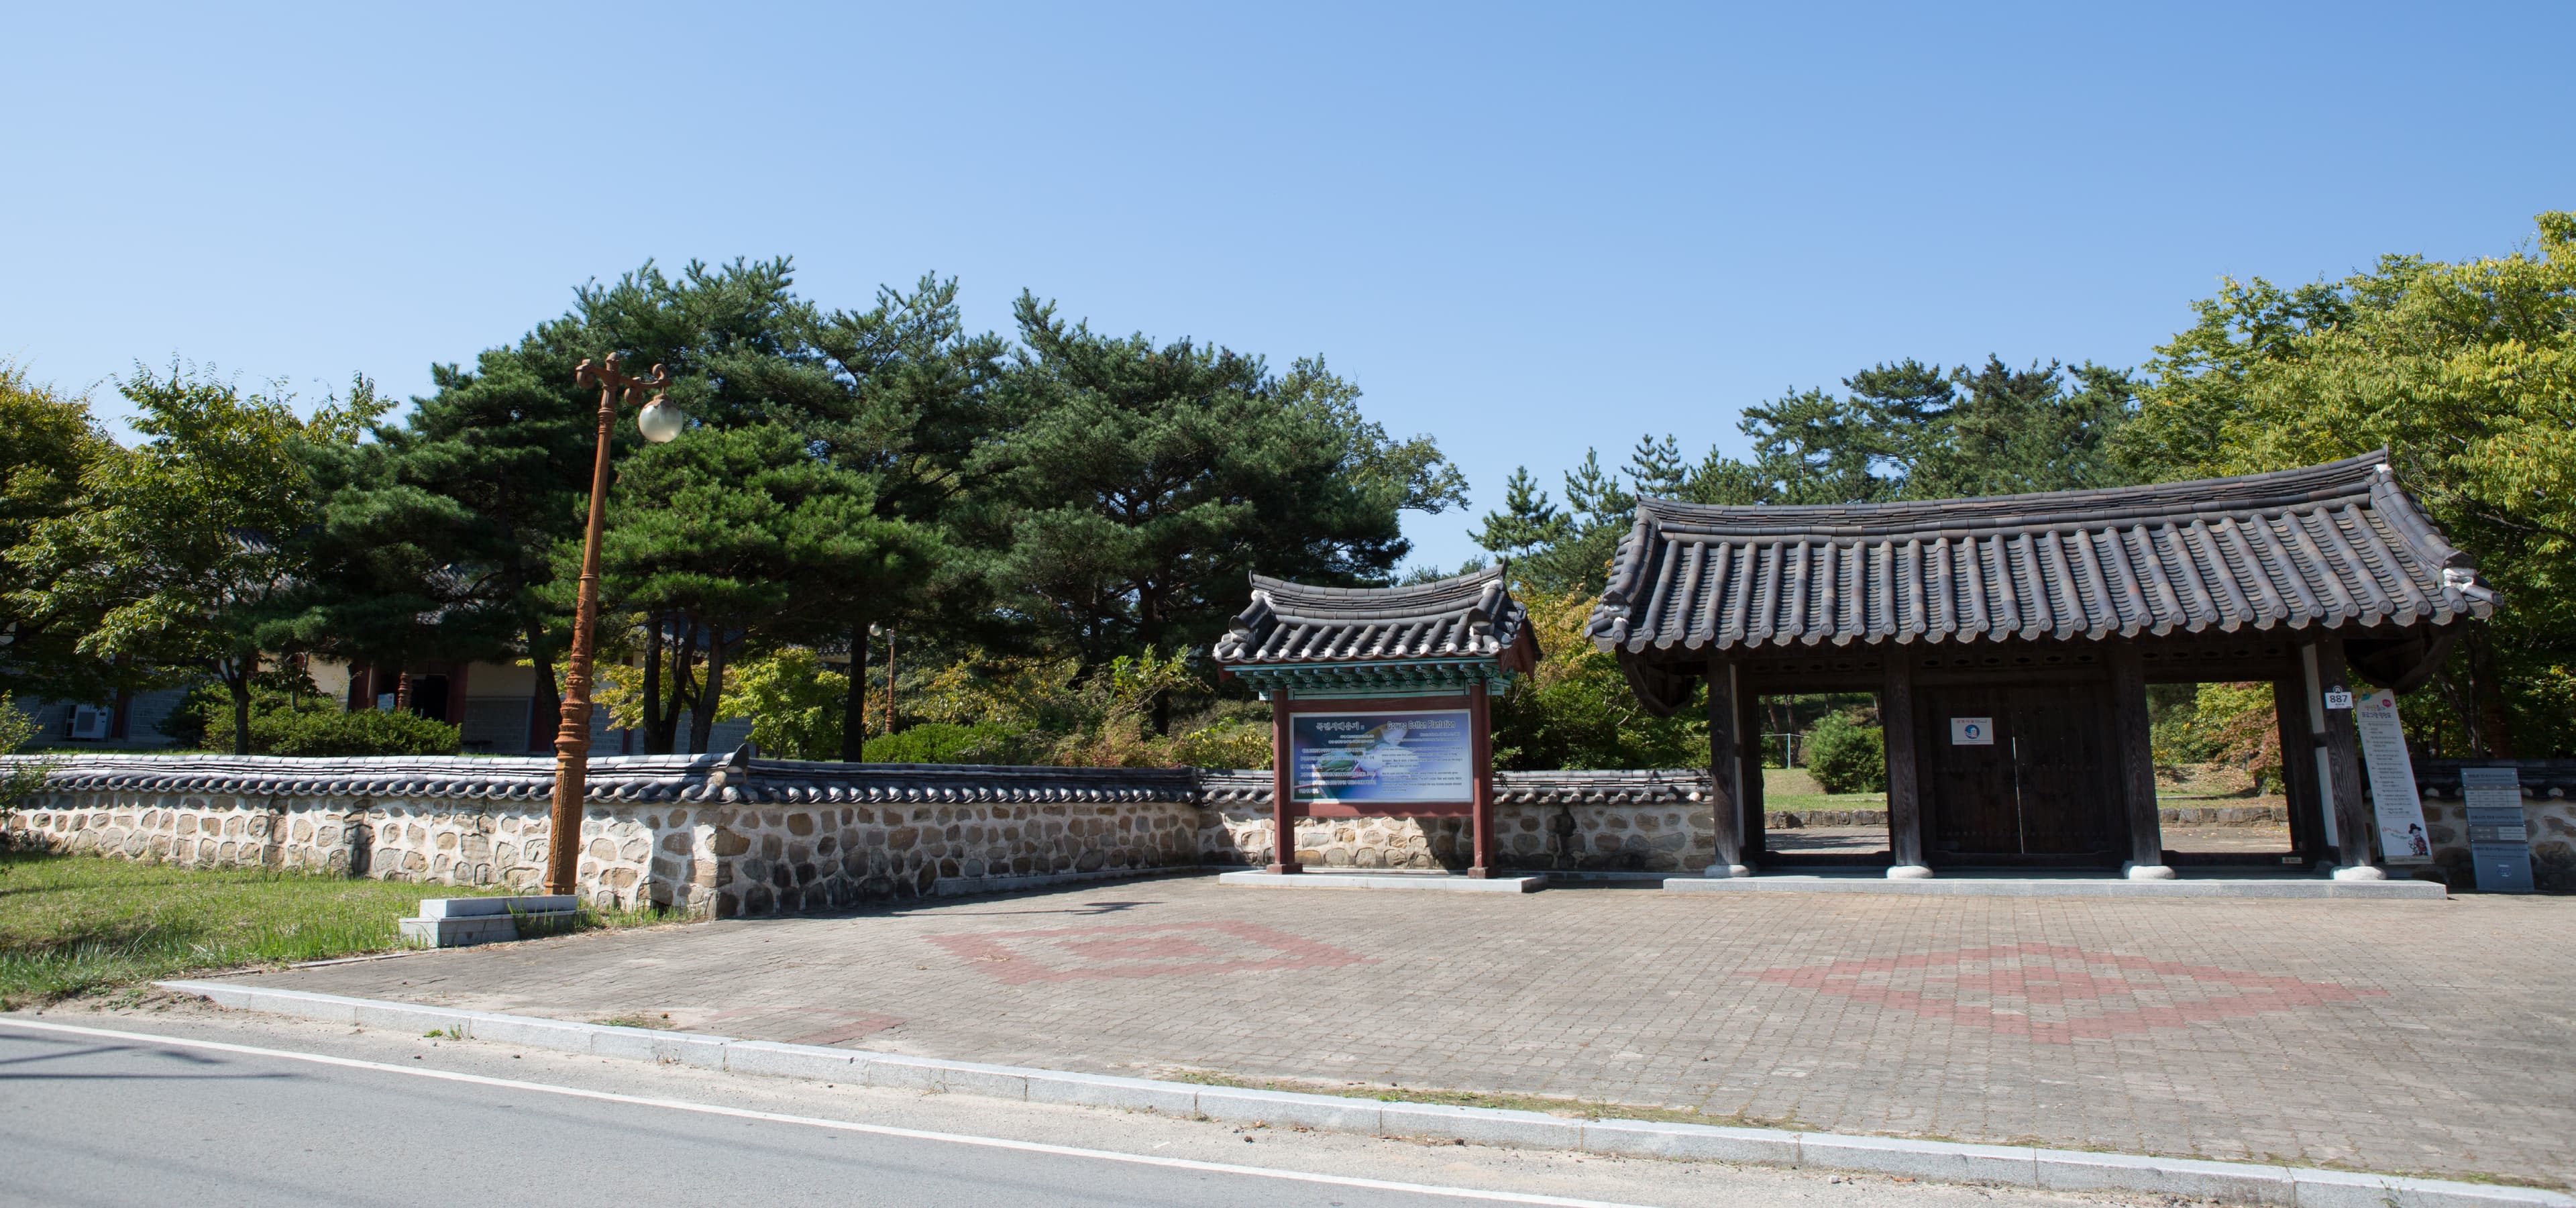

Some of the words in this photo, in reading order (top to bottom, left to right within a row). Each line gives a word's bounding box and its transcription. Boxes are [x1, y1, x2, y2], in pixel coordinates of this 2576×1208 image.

[2329, 695, 2348, 703] 887
[1408, 720, 1427, 729] Cotton
[1428, 720, 1455, 728] Plantation
